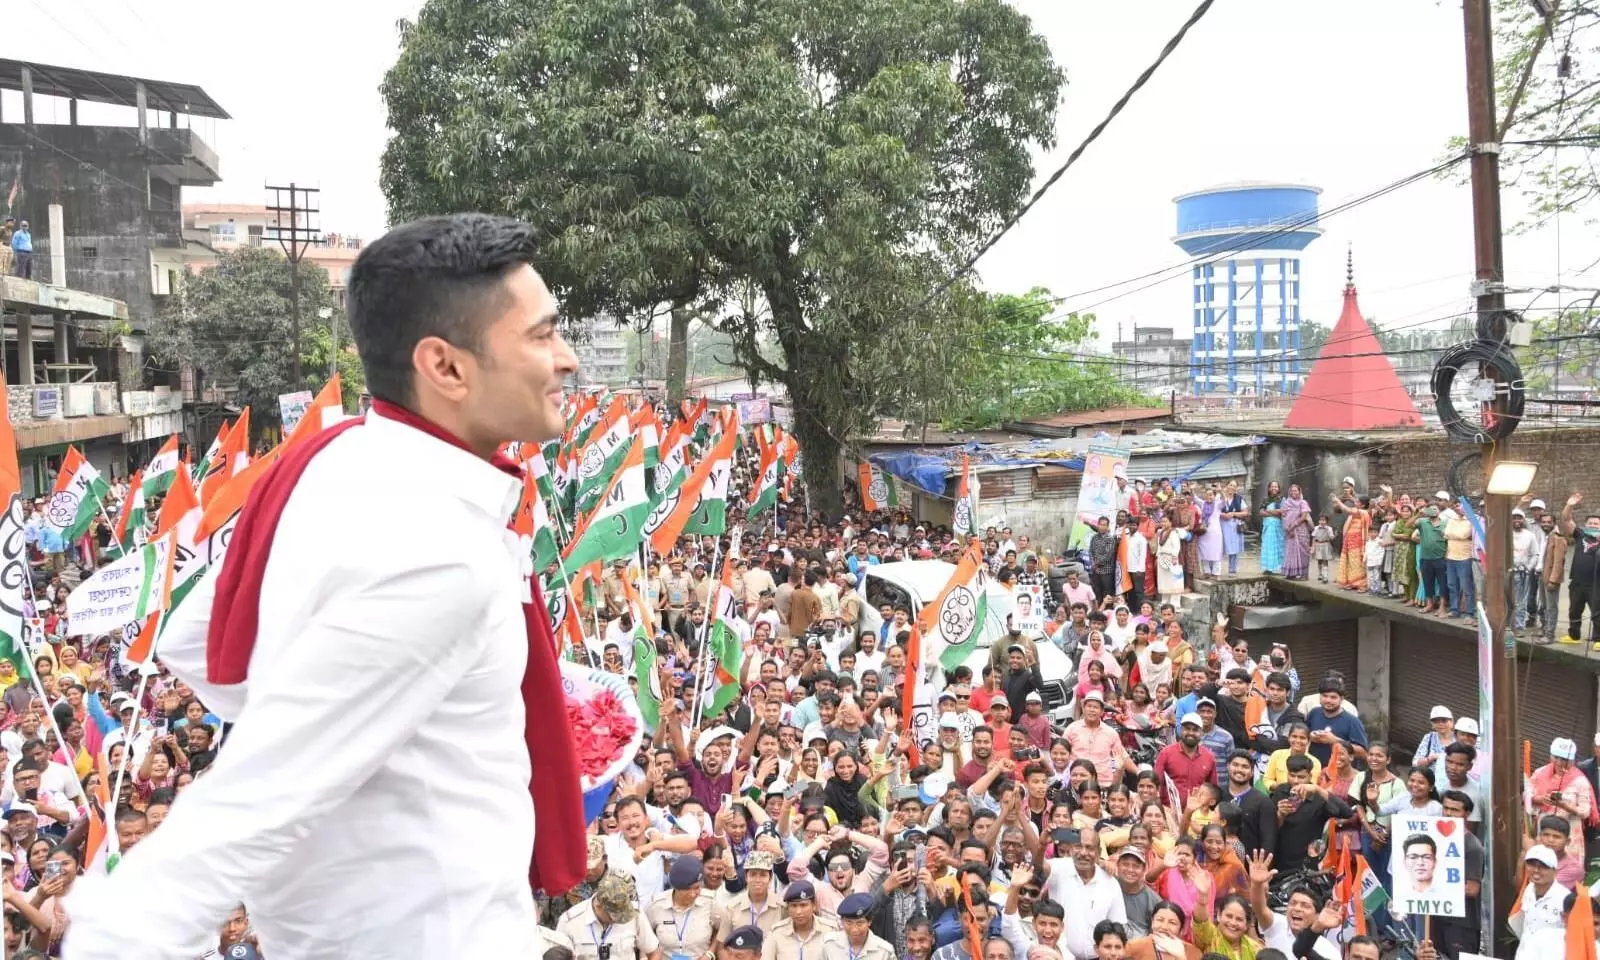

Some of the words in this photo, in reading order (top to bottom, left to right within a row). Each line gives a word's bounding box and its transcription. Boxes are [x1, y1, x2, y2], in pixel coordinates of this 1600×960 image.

[607, 431, 620, 447] M
[1406, 820, 1428, 832] WE
[1445, 841, 1461, 857] A
[1446, 867, 1461, 883] B
[1405, 899, 1453, 914] TMYC
